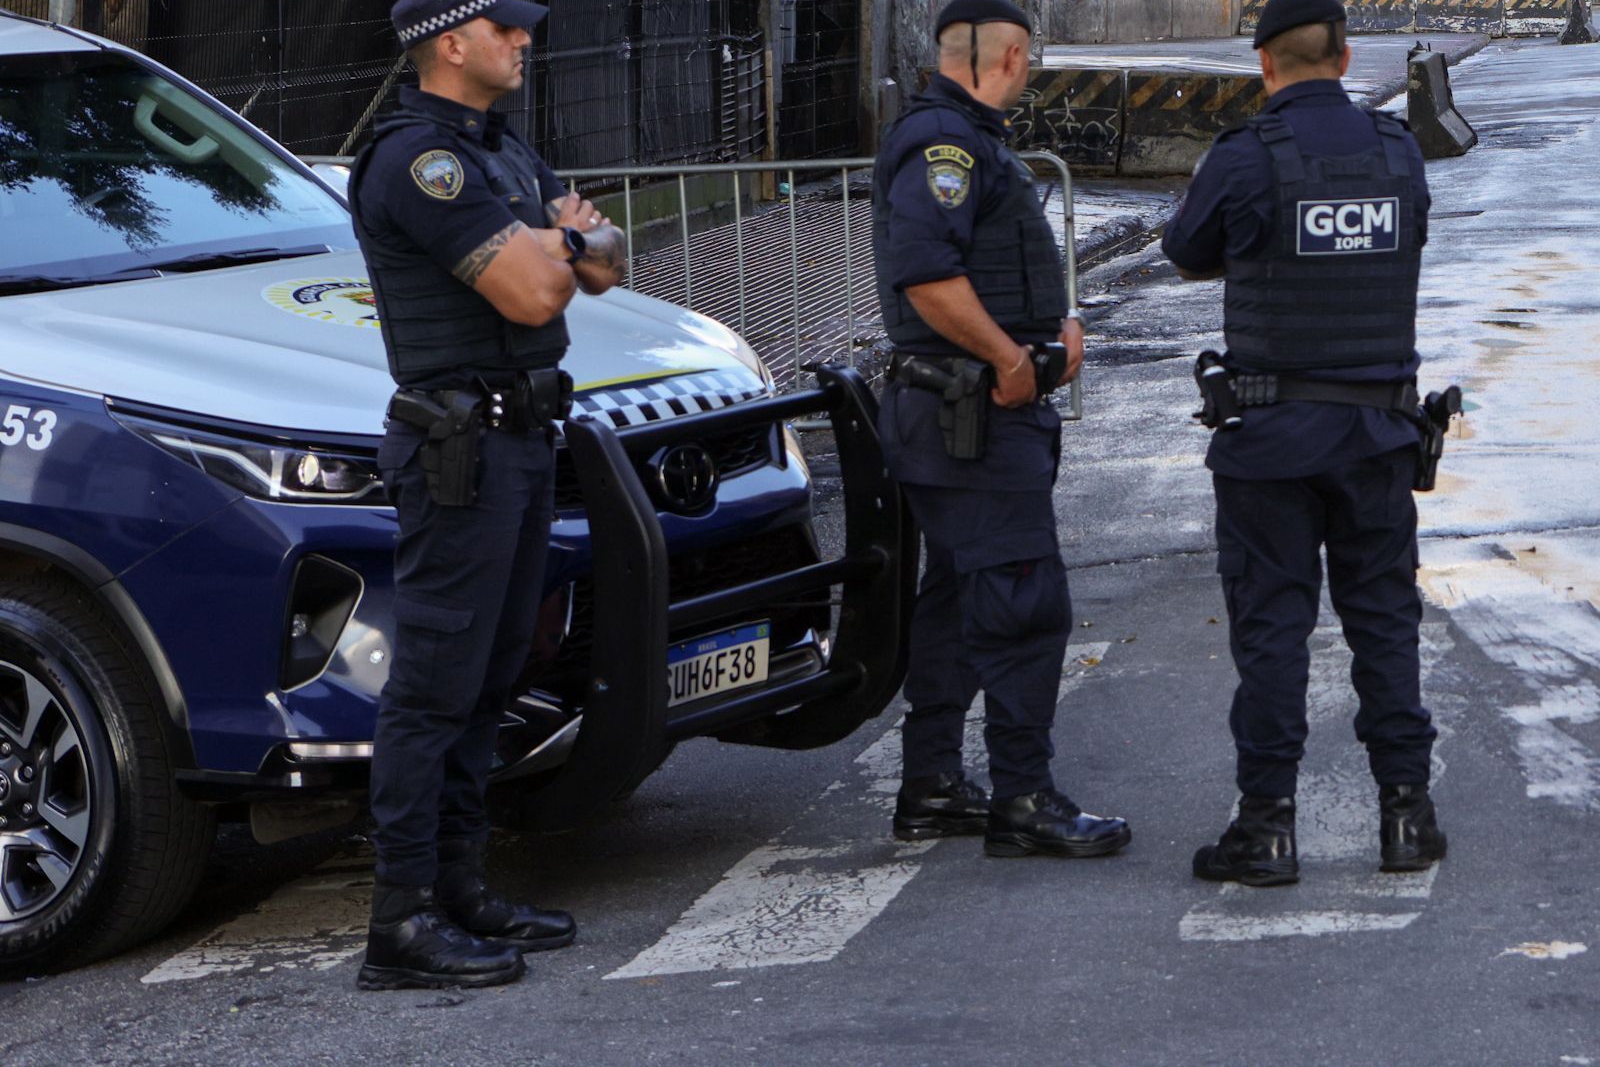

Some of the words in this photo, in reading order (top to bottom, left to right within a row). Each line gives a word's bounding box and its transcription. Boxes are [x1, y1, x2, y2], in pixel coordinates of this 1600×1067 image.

[1304, 202, 1393, 236] GCM
[1334, 236, 1373, 251] IOPE
[0, 404, 58, 451] 53
